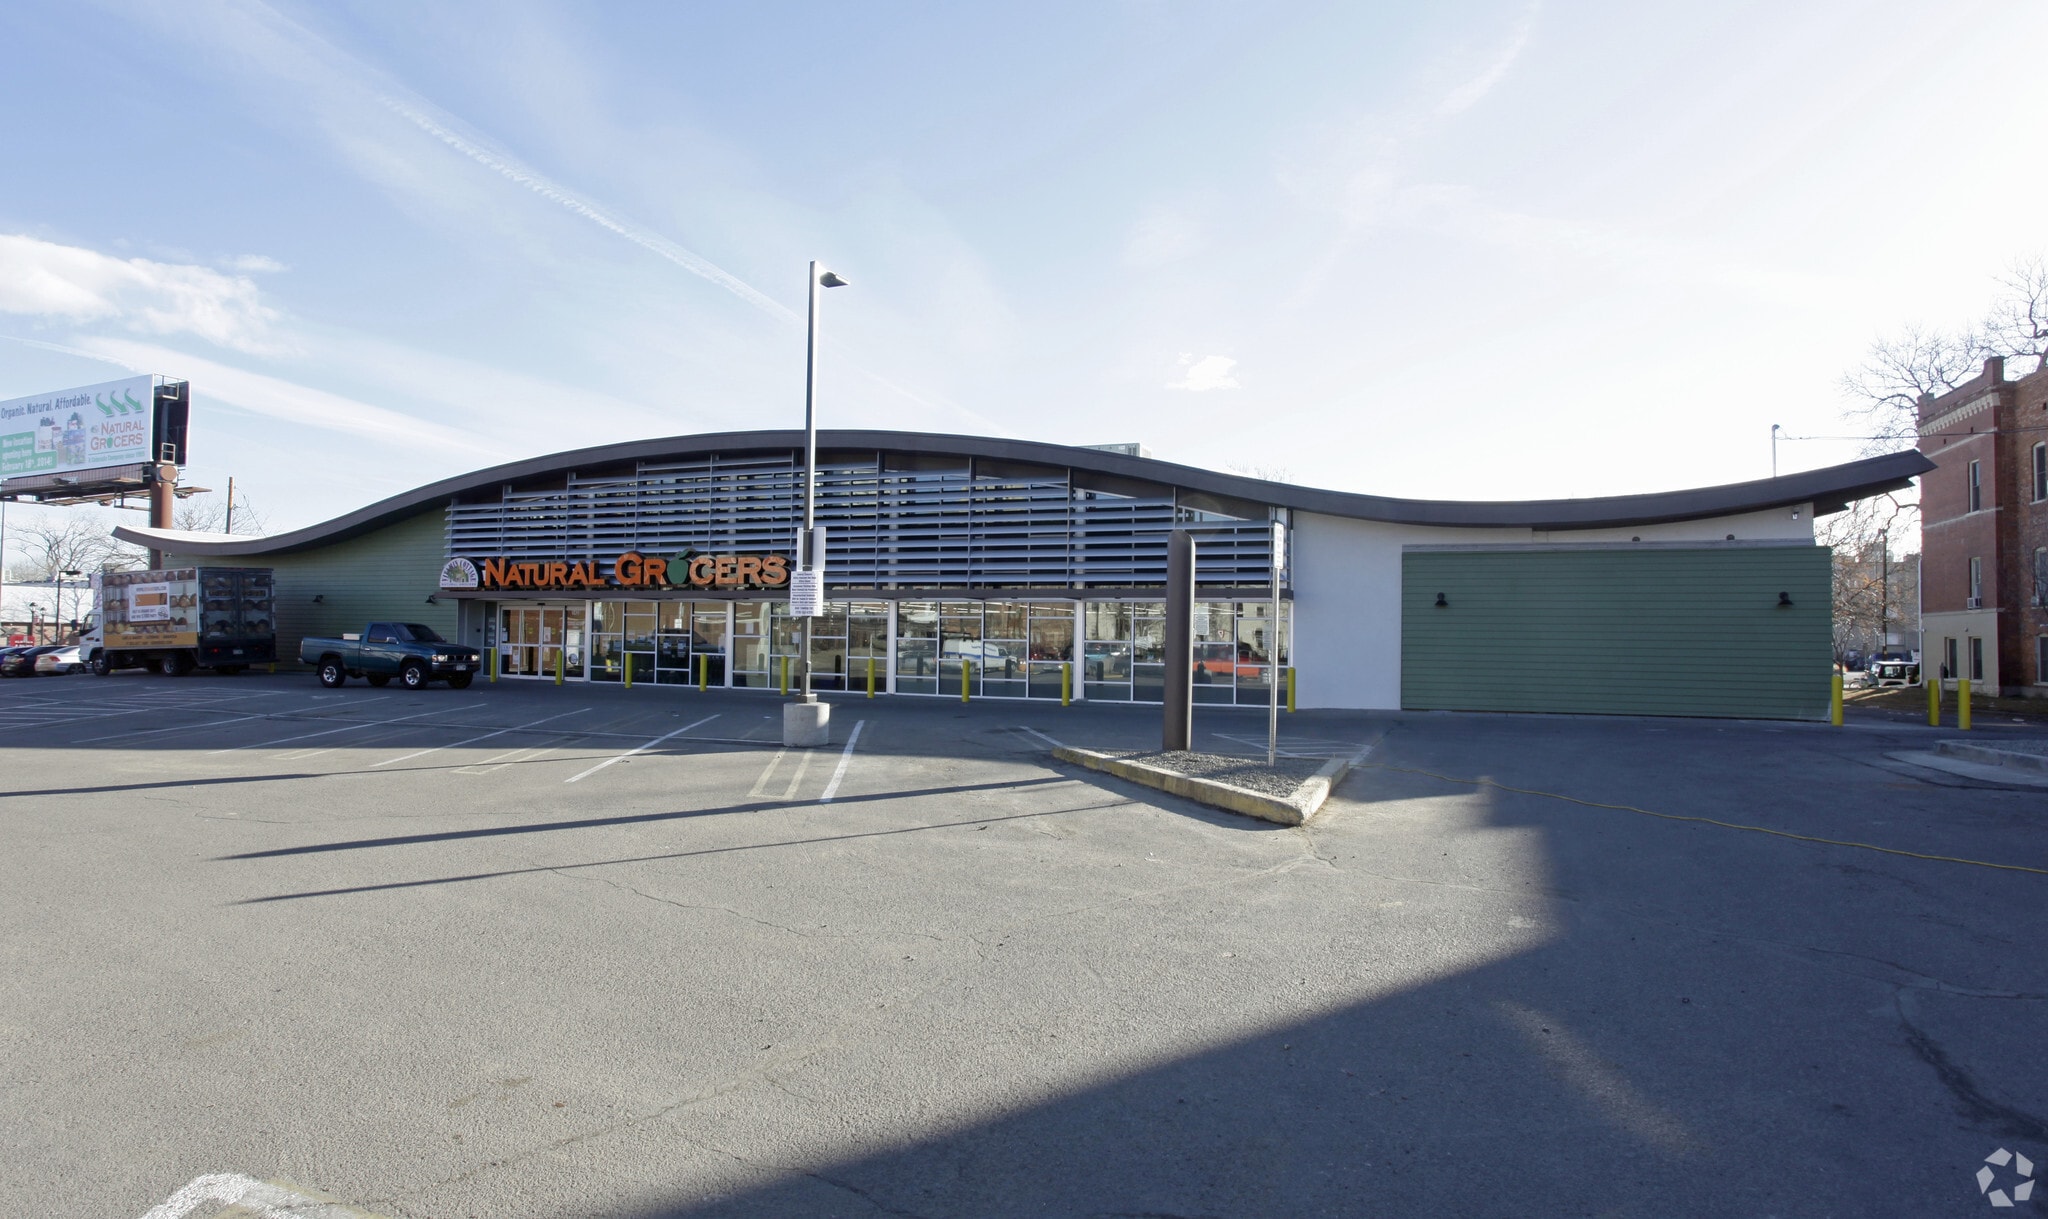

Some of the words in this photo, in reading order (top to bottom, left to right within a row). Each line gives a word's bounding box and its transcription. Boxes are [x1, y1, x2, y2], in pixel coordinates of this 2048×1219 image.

[1, 406, 26, 420] Organic.
[27, 400, 53, 414] Natural.
[55, 393, 92, 410] Affordable.
[101, 420, 144, 435] NATURAL
[484, 557, 605, 586] NATURAL
[614, 551, 790, 586] GROCERS
